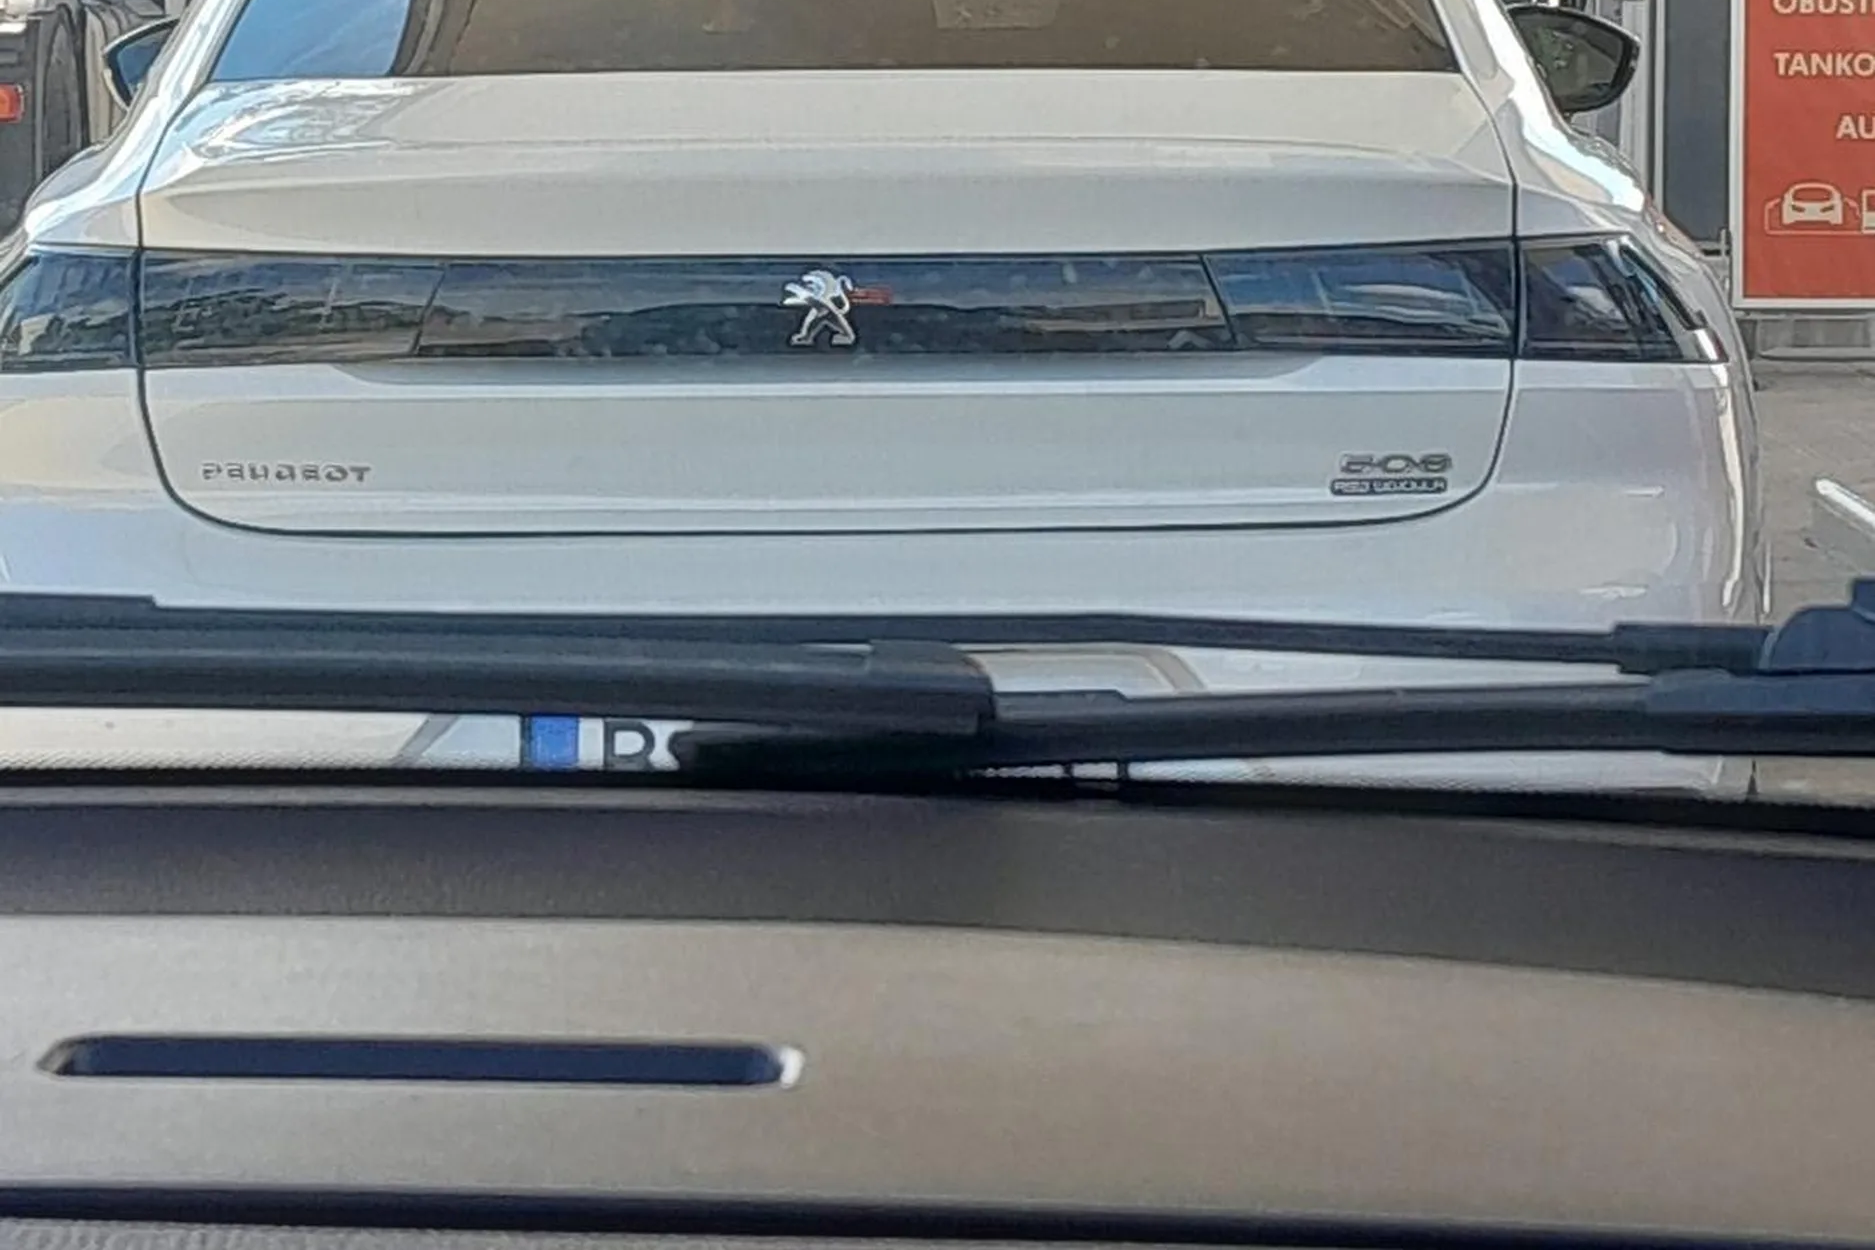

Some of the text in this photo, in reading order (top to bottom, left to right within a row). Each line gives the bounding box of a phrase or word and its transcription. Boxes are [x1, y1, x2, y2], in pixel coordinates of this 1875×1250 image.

[1772, 52, 1875, 77] TANKO
[1835, 114, 1875, 140] AU
[202, 461, 371, 482] PEUGEOT
